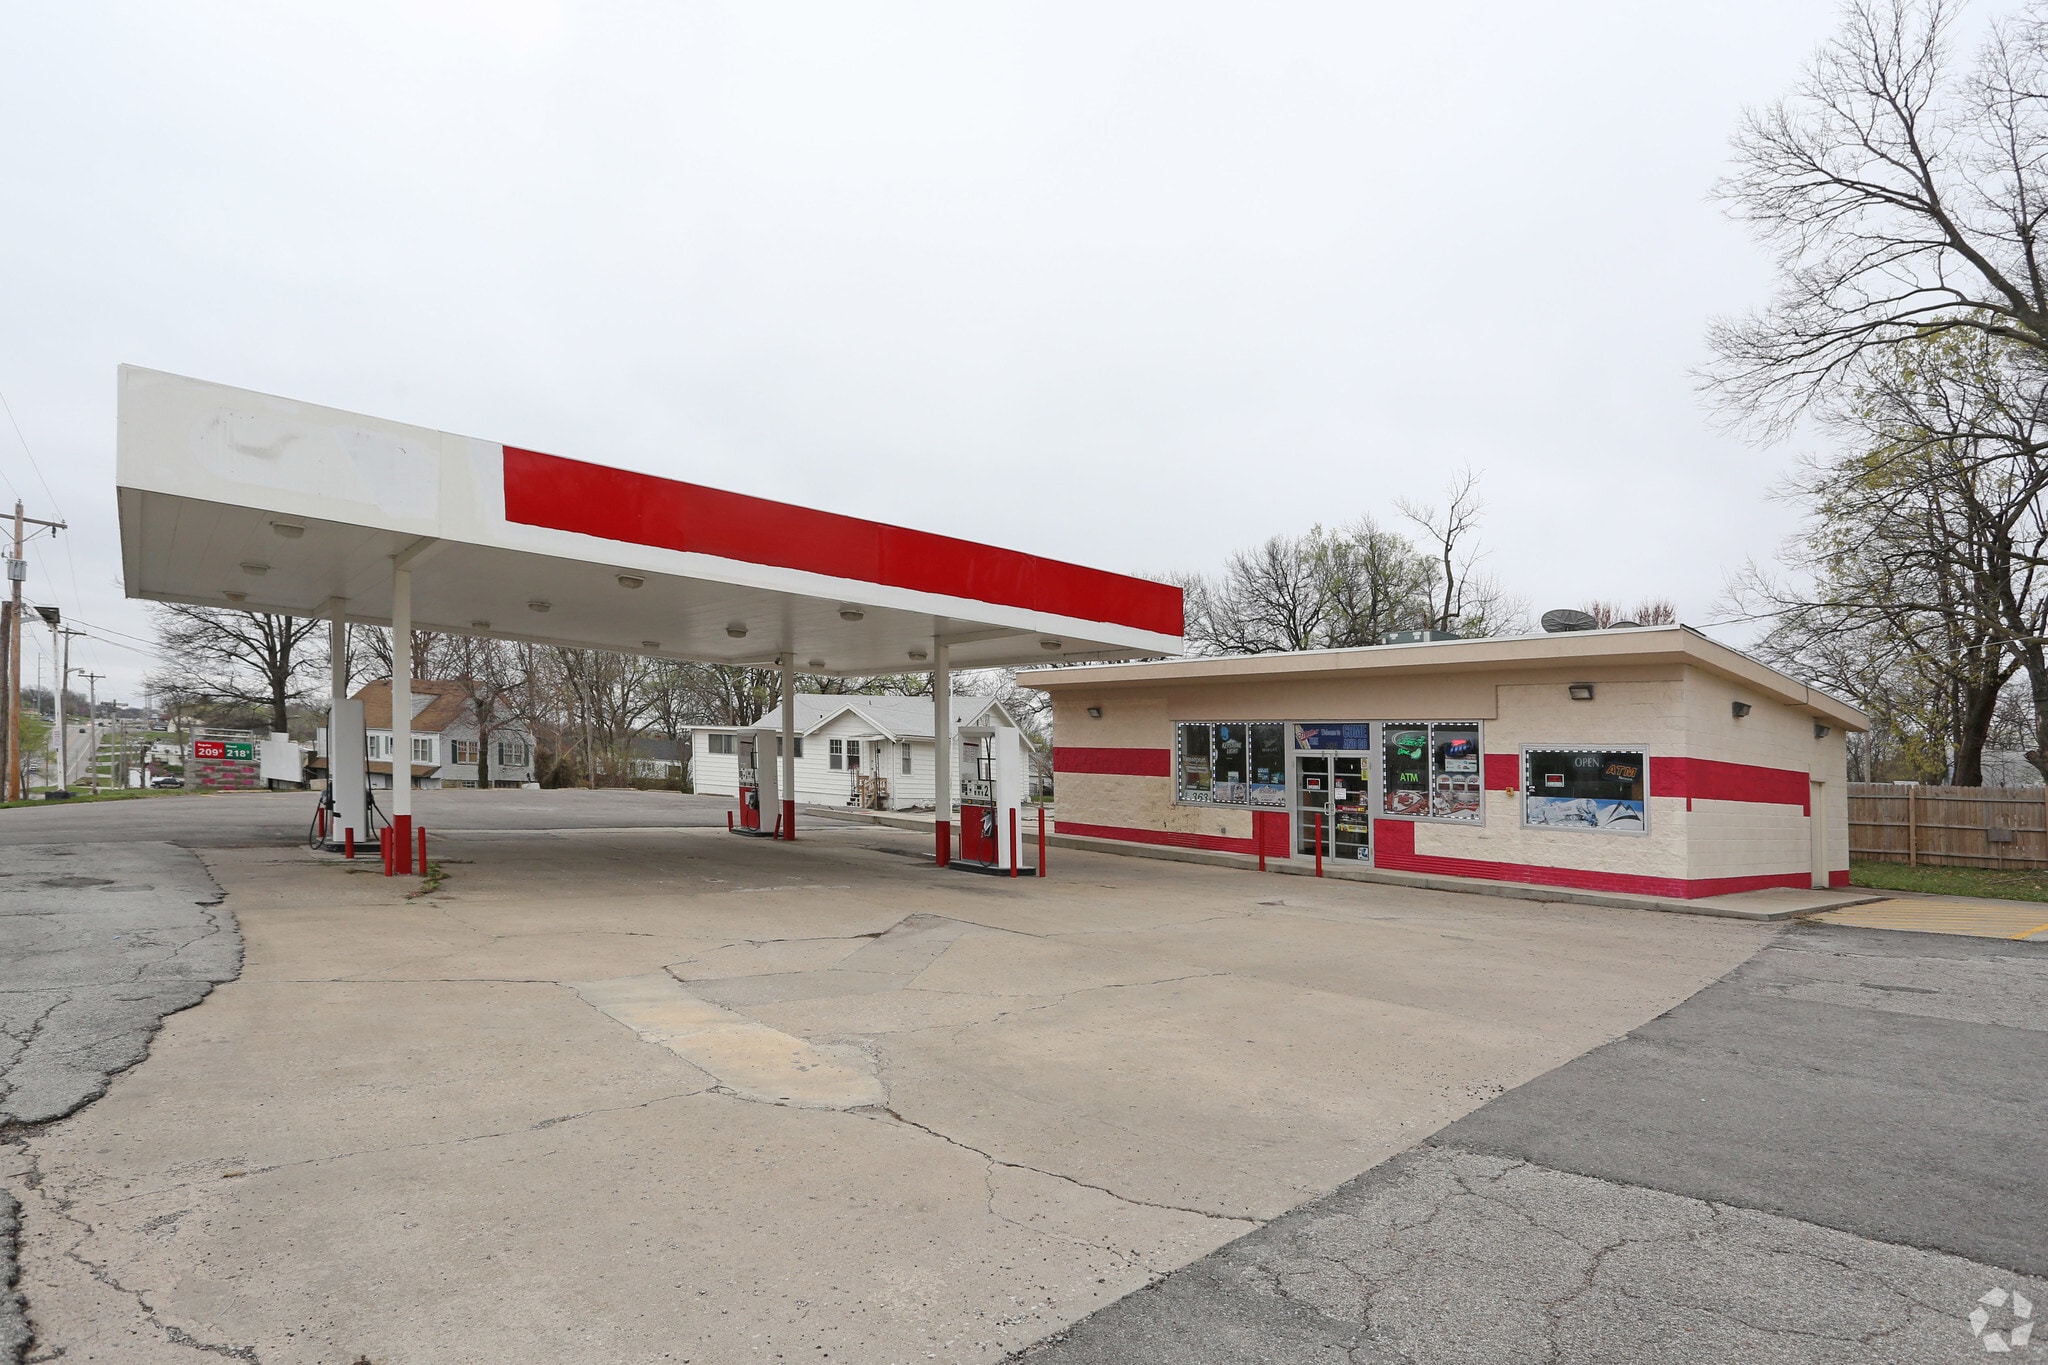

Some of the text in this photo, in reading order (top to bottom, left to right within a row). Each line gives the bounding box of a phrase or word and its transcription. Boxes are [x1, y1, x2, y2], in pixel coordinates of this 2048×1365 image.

[1343, 725, 1367, 738] COME
[1575, 757, 1600, 767] OPEN
[1606, 764, 1637, 778] ATM
[1399, 772, 1419, 782] ATM
[984, 785, 989, 796] 2
